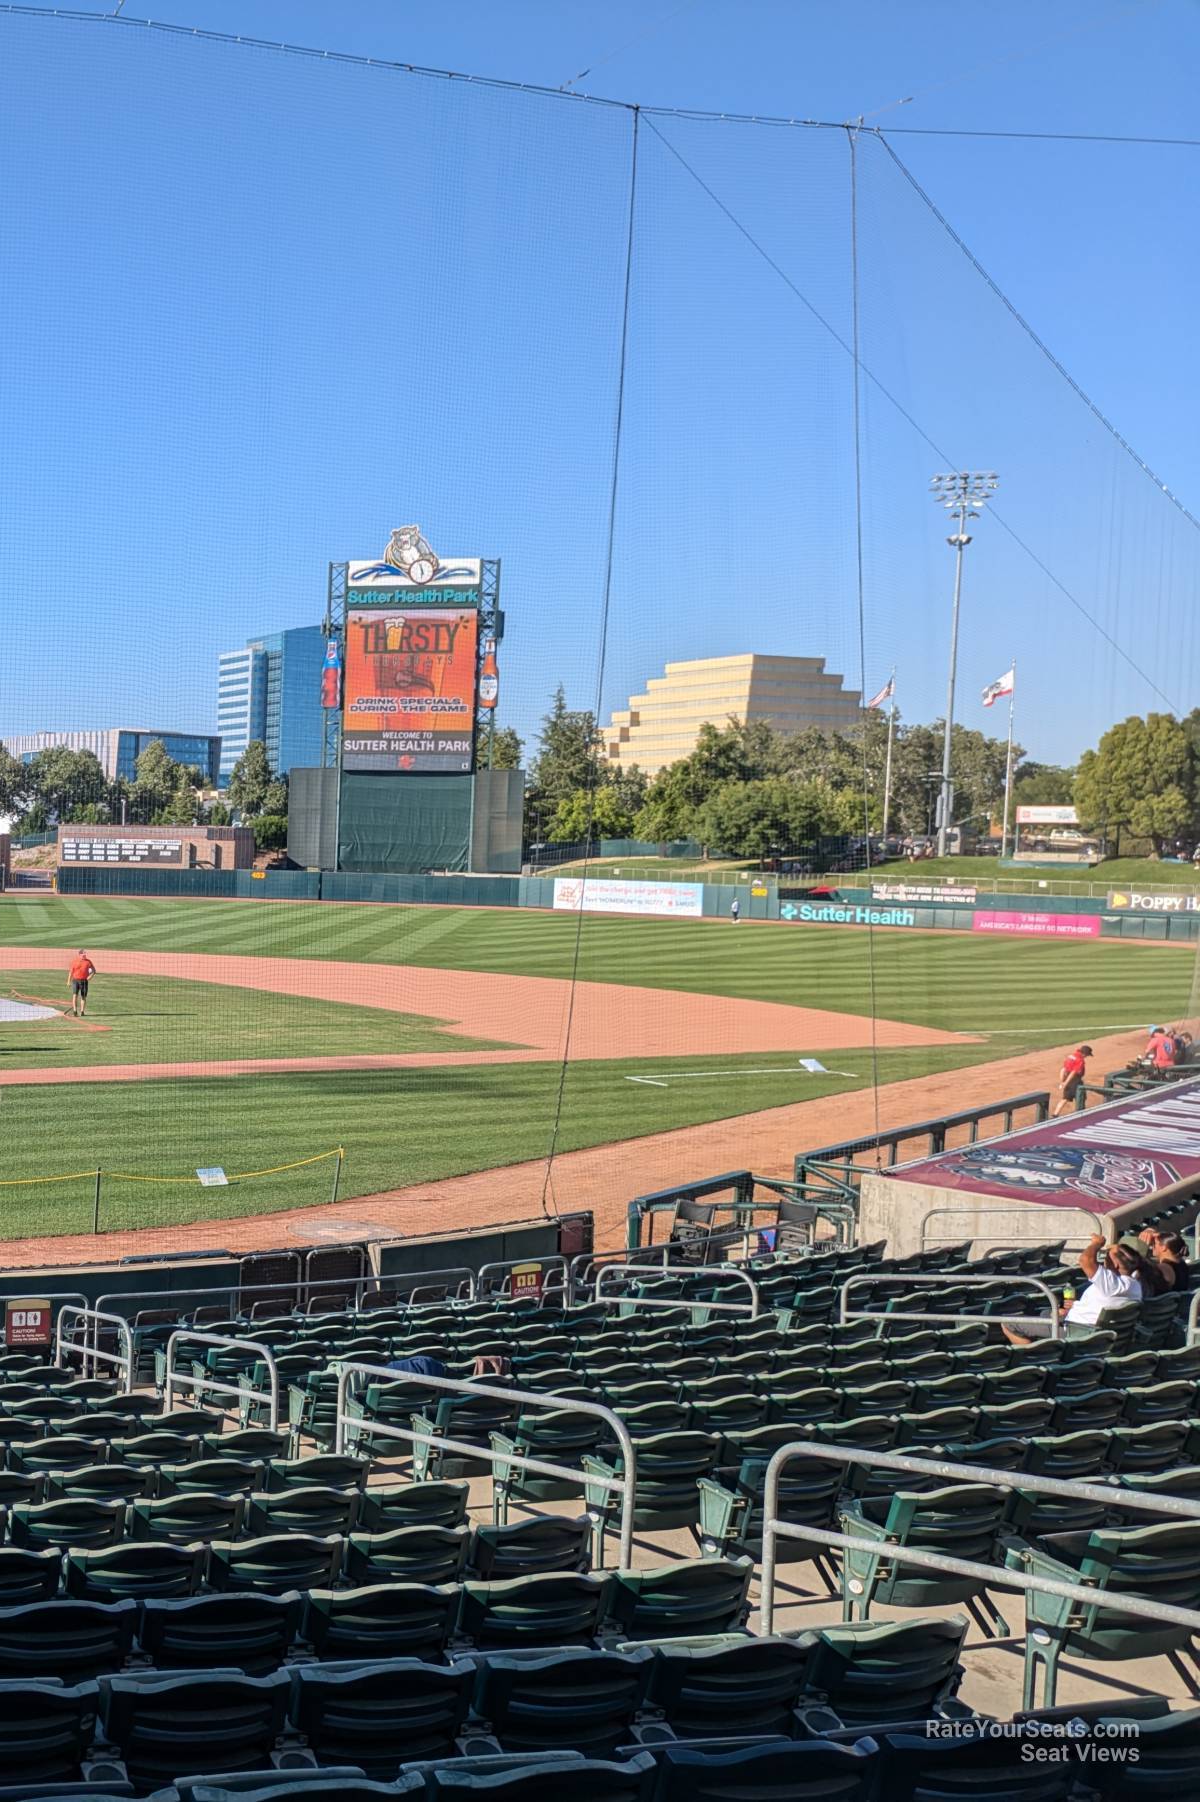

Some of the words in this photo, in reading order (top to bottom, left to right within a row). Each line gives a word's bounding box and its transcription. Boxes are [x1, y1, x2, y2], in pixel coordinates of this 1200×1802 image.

[348, 590, 393, 603] Sutter
[395, 589, 442, 603] Health
[444, 589, 477, 602] Park
[356, 697, 395, 705] DRINK
[400, 697, 461, 705] SPECIALS
[382, 731, 421, 739] WELCOME
[422, 731, 433, 739] TO
[344, 740, 388, 751] SUTTER
[390, 740, 435, 751] HEALTH
[438, 740, 470, 751] PARK
[1131, 894, 1183, 910] POPPY
[800, 905, 853, 922] Sutter
[855, 906, 914, 926] Health
